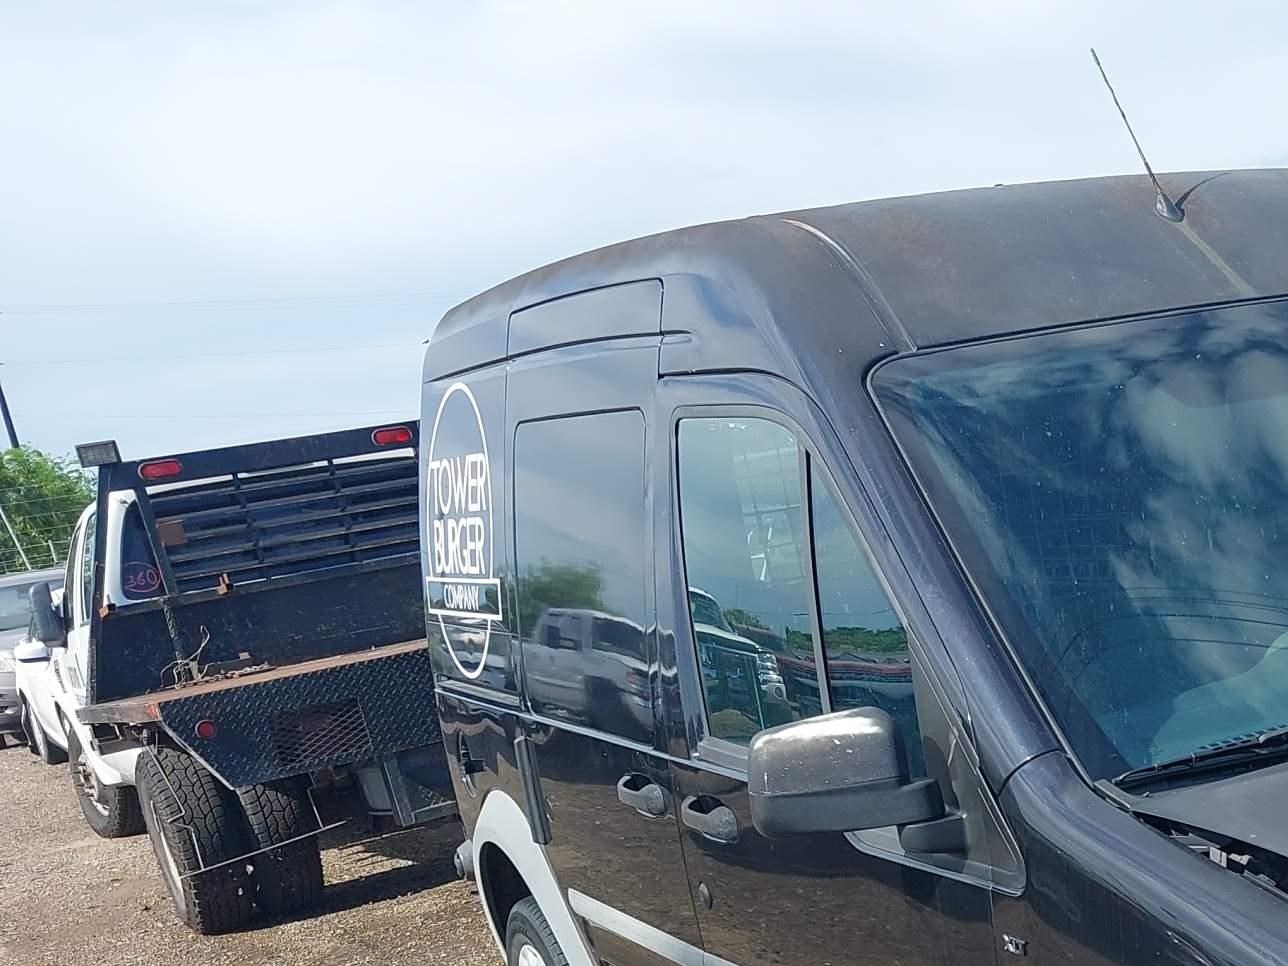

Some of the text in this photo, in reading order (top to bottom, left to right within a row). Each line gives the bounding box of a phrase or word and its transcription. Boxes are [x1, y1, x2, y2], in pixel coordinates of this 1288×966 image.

[430, 452, 488, 516] TOWER
[433, 516, 487, 576] BURGER
[443, 584, 480, 612] COMPANY
